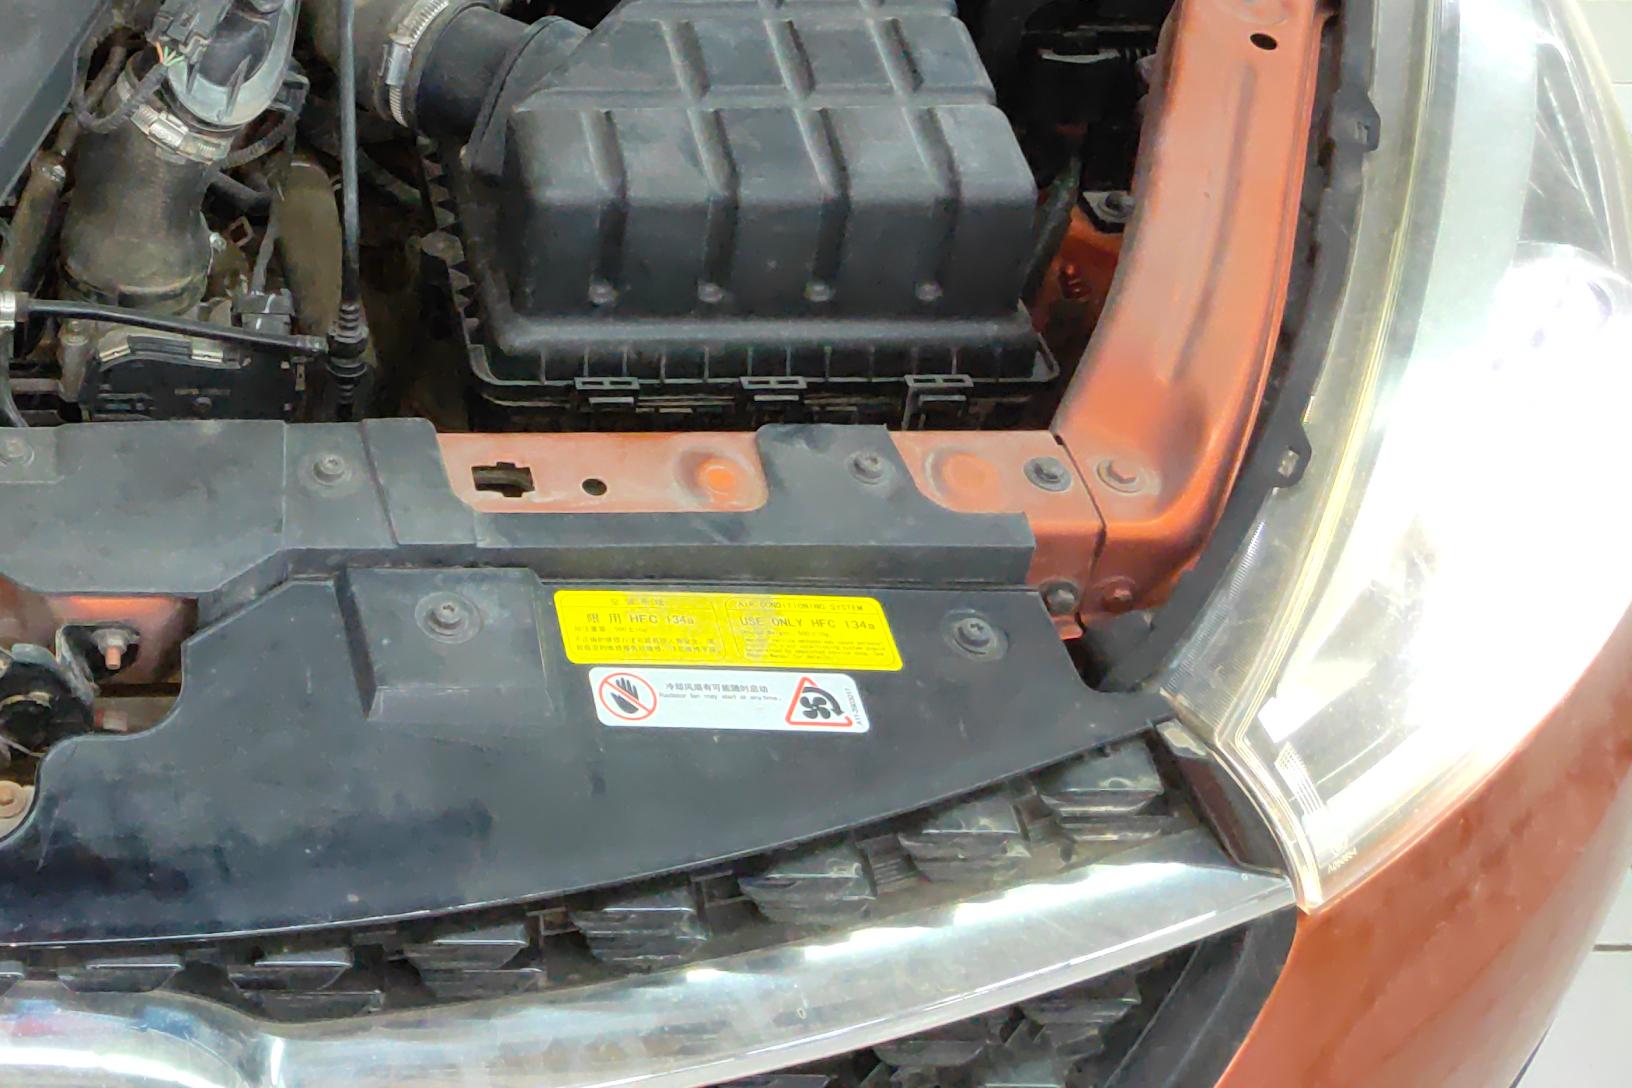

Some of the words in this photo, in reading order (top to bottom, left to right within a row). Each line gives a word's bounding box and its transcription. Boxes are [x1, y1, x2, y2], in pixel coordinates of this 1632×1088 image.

[629, 614, 658, 623] HFC
[739, 616, 764, 626] USE
[771, 617, 803, 627] ONLY
[811, 619, 836, 628] HFC
